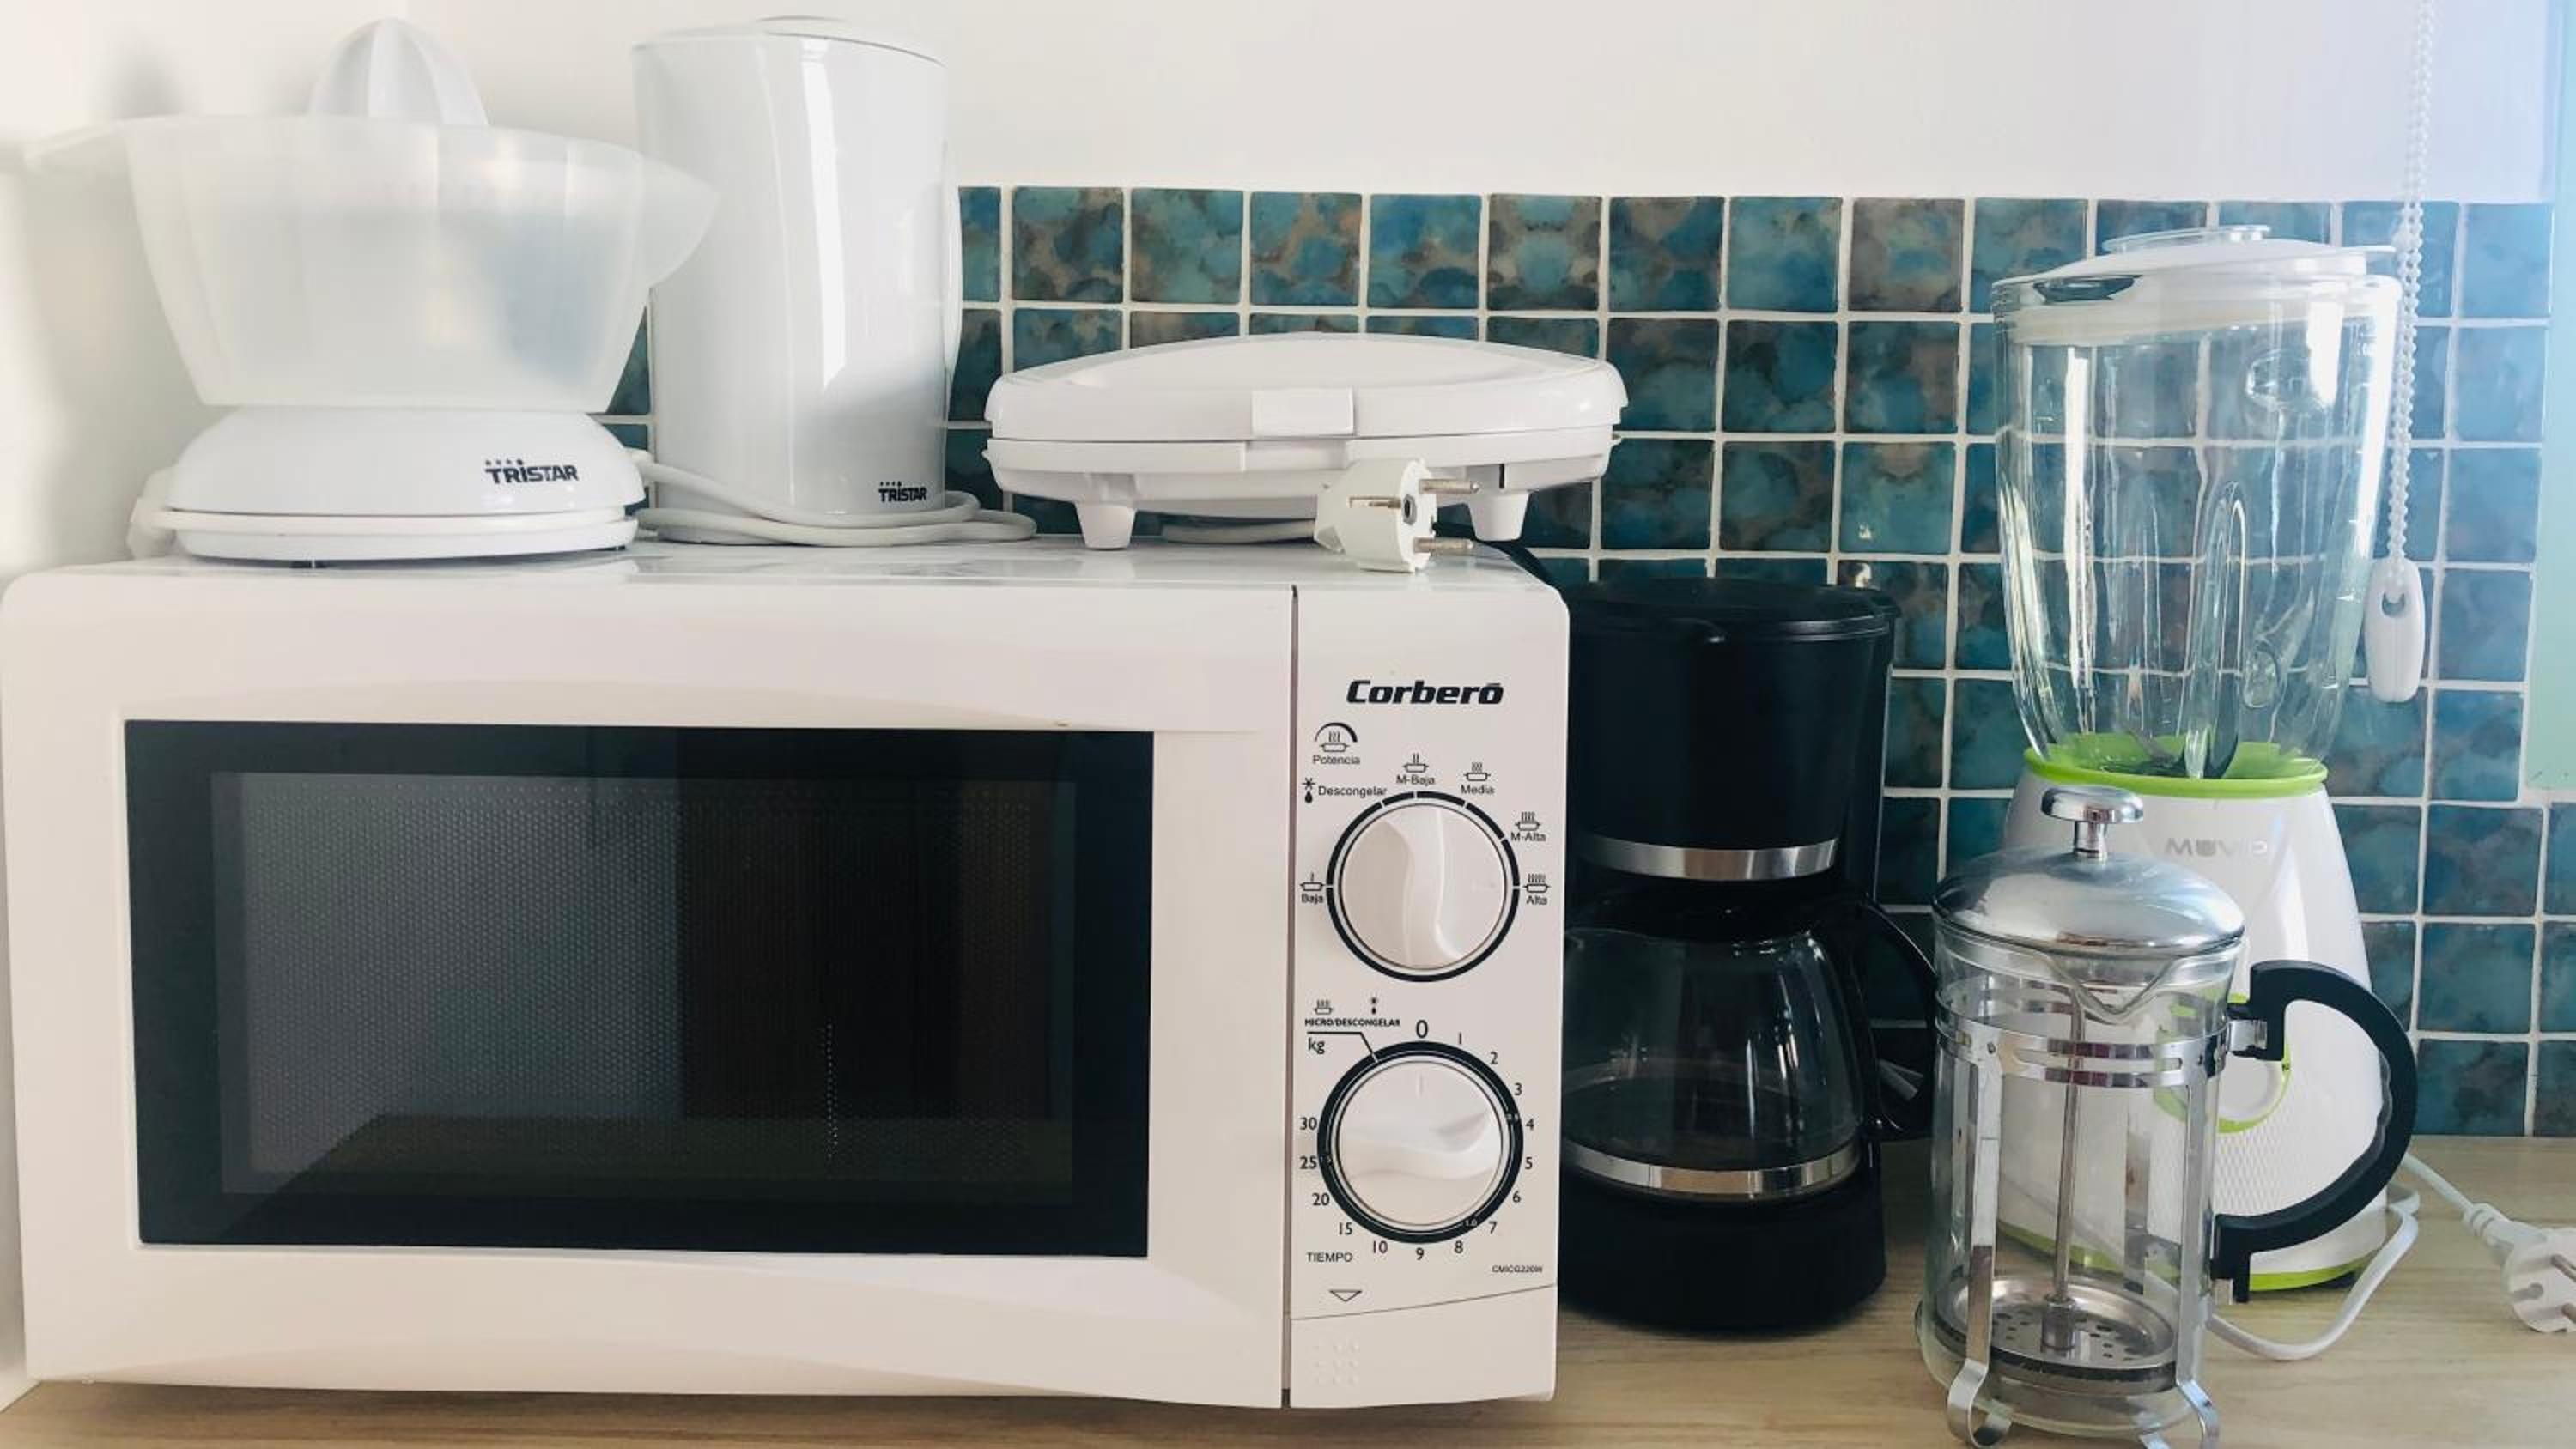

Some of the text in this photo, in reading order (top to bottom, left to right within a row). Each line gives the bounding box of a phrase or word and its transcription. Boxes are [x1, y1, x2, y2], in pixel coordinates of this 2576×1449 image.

[484, 464, 580, 484] TRISTAR
[878, 486, 927, 503] TRISTAR
[1312, 755, 1361, 765] Potencia
[1395, 774, 1436, 786] M-Baja
[1318, 785, 1387, 798] Descongelar
[1461, 785, 1495, 795] Media
[1510, 832, 1546, 842] M-Alta
[1301, 894, 1324, 905] Baja
[1526, 895, 1547, 906] Alta
[1415, 1019, 1429, 1039] 0
[1308, 1037, 1326, 1055] kg
[1489, 1051, 1498, 1065] 2
[1514, 1082, 1522, 1096] 3
[1299, 1117, 1318, 1131] 30
[1526, 1119, 1534, 1131] 4
[1299, 1155, 1317, 1170] 25
[1525, 1156, 1533, 1170] 5
[1311, 1192, 1330, 1206] 20
[1512, 1191, 1521, 1203] 6
[1339, 1222, 1353, 1236] 15
[1488, 1221, 1498, 1234] 7
[1372, 1240, 1388, 1254] 10
[1416, 1247, 1425, 1260] 9
[1454, 1240, 1463, 1254] 8
[1306, 1252, 1353, 1263] TIEMPO
